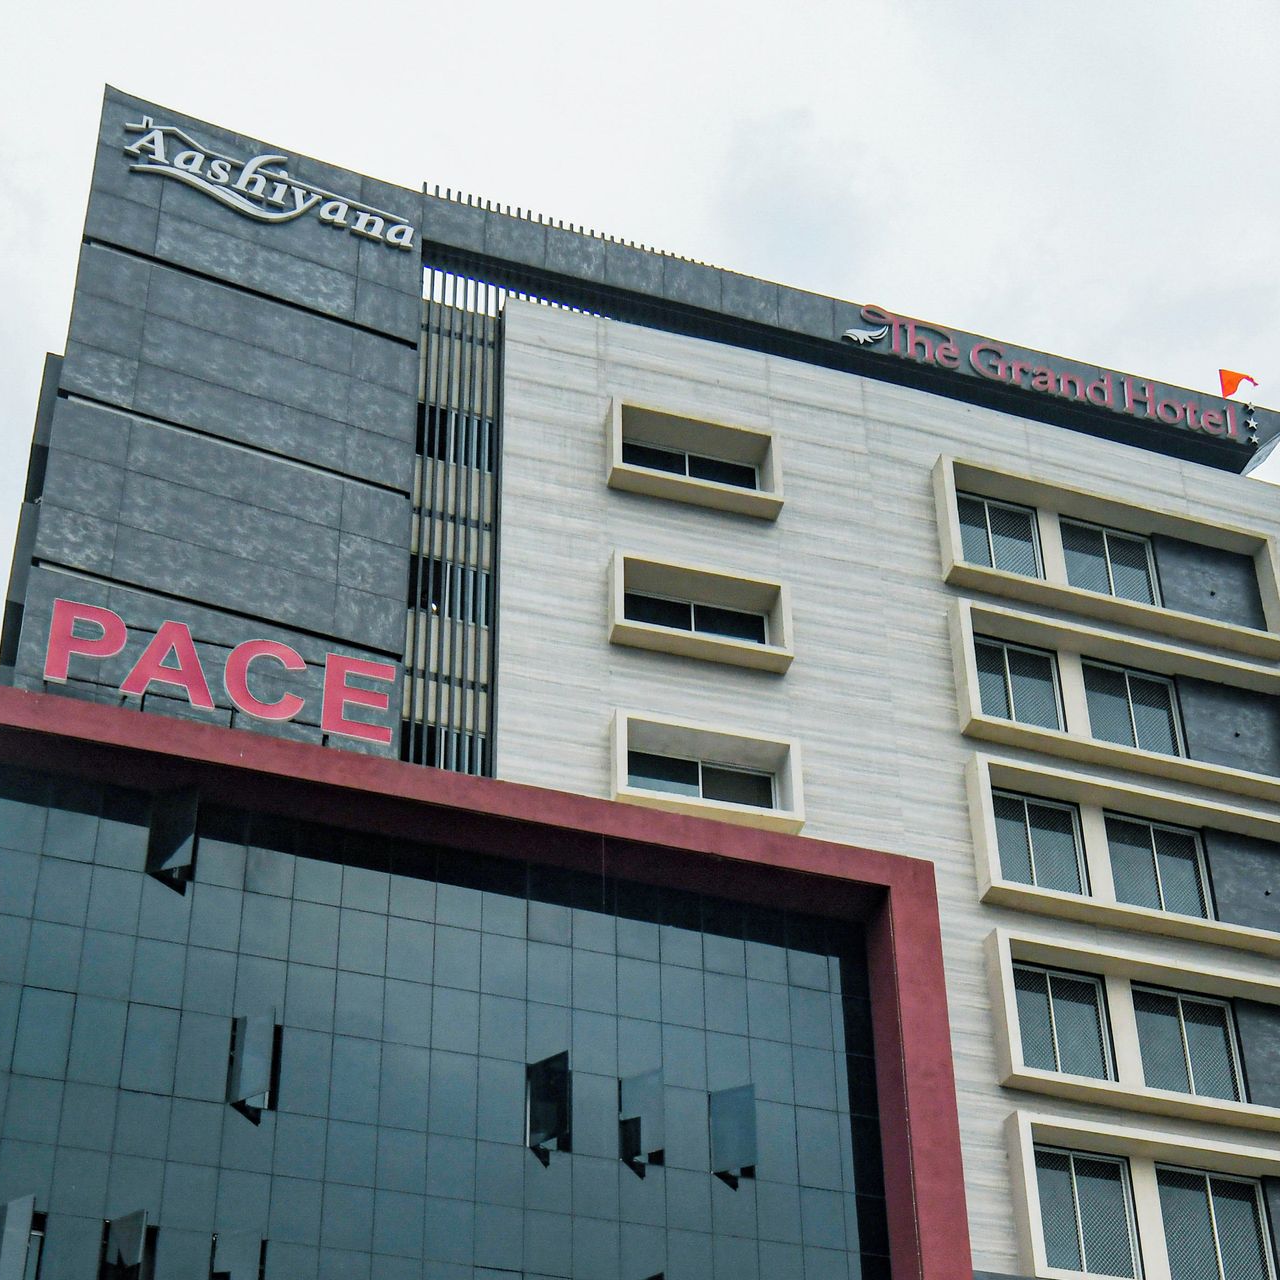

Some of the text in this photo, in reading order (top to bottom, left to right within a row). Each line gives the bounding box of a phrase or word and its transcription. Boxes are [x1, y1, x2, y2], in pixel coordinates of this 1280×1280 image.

[124, 125, 414, 249] Aashiyana
[860, 304, 1239, 440] The Grand Hotel
[43, 597, 396, 745] PACE
